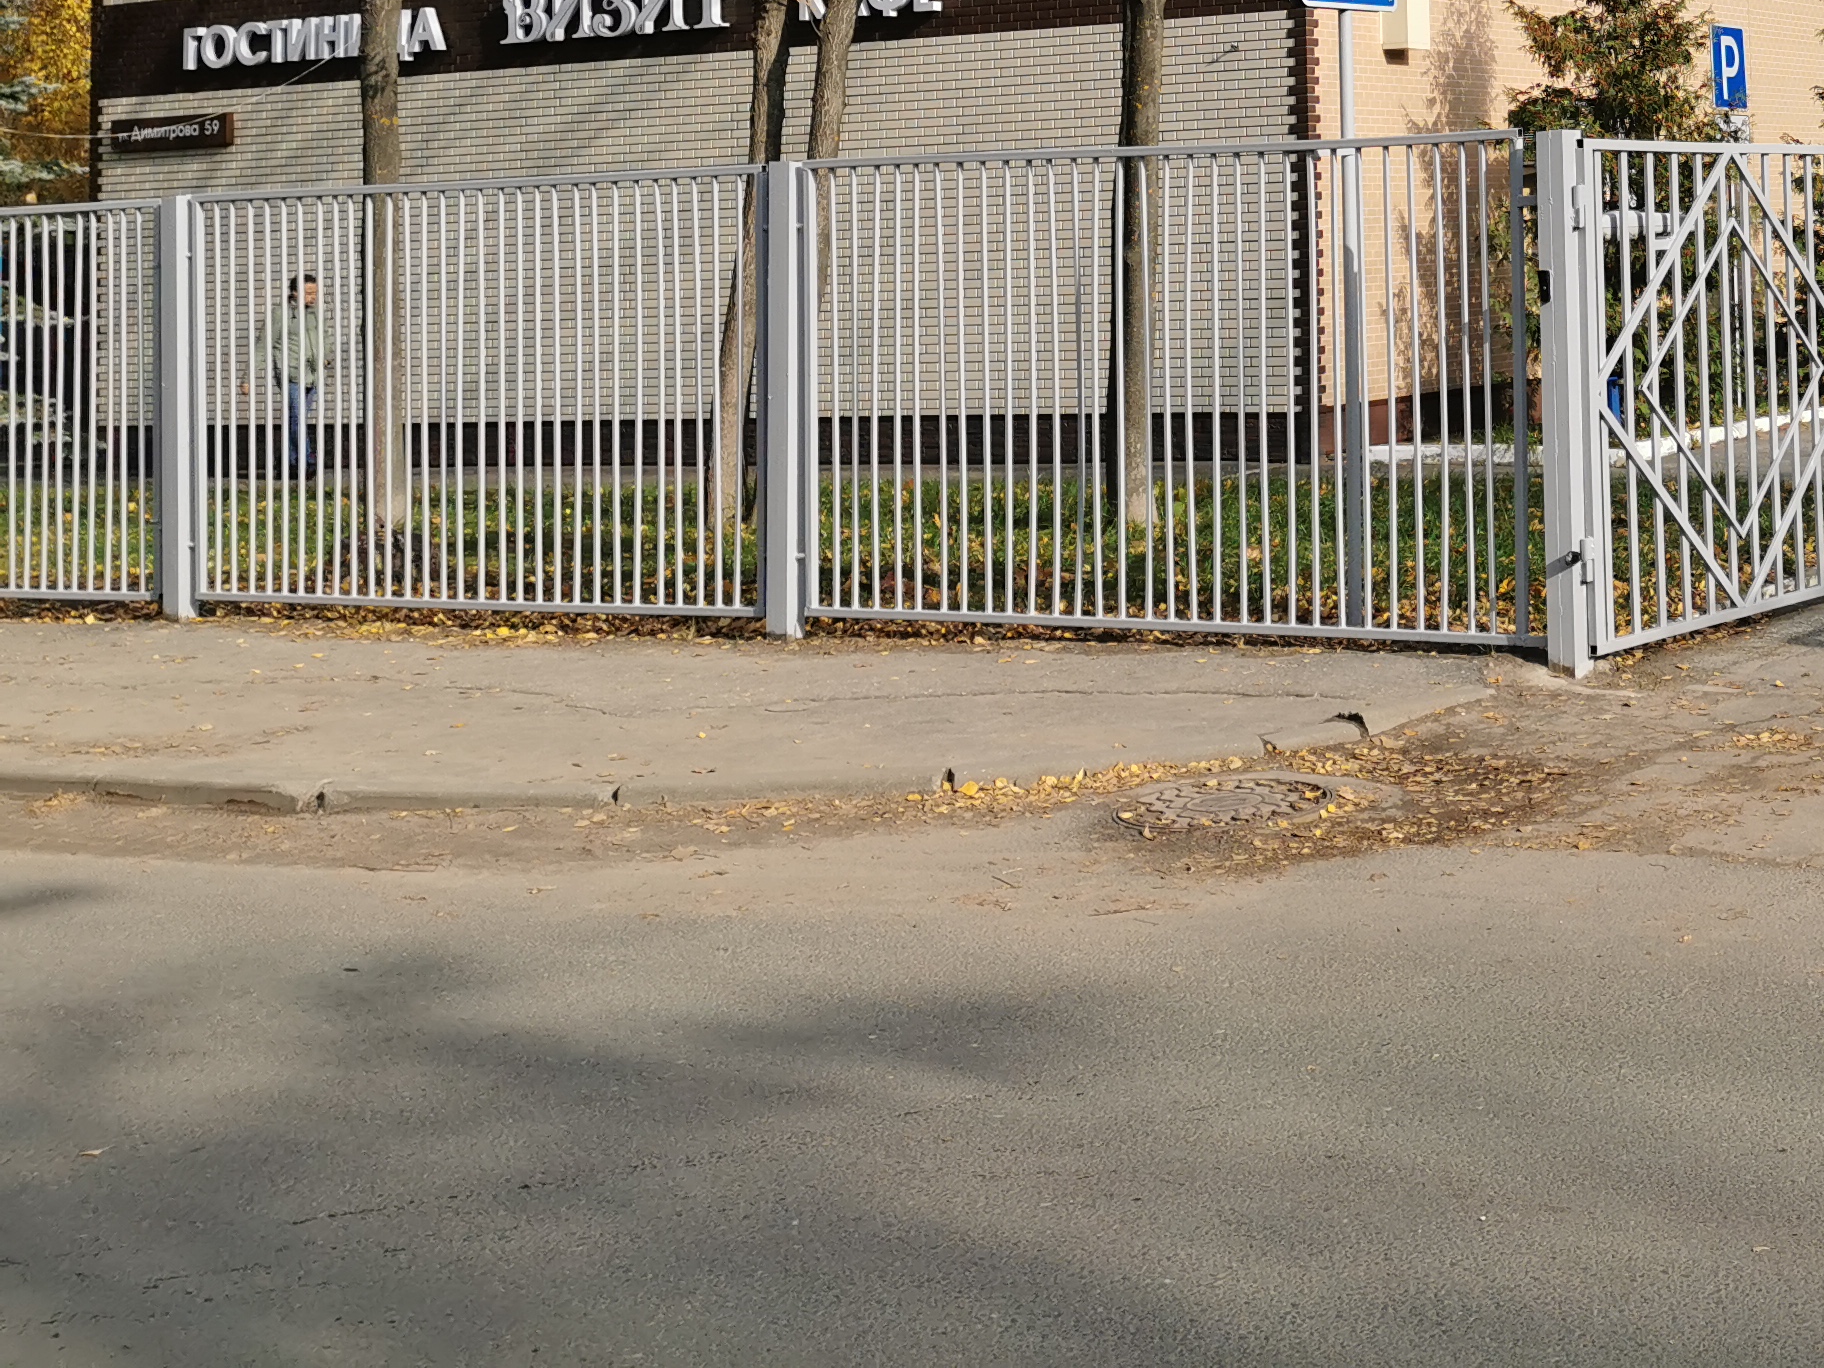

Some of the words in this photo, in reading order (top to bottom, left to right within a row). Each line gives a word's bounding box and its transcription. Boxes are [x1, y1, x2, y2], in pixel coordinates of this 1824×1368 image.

[1720, 35, 1740, 100] P
[131, 124, 200, 143] Димитрова
[203, 120, 220, 136] 59
